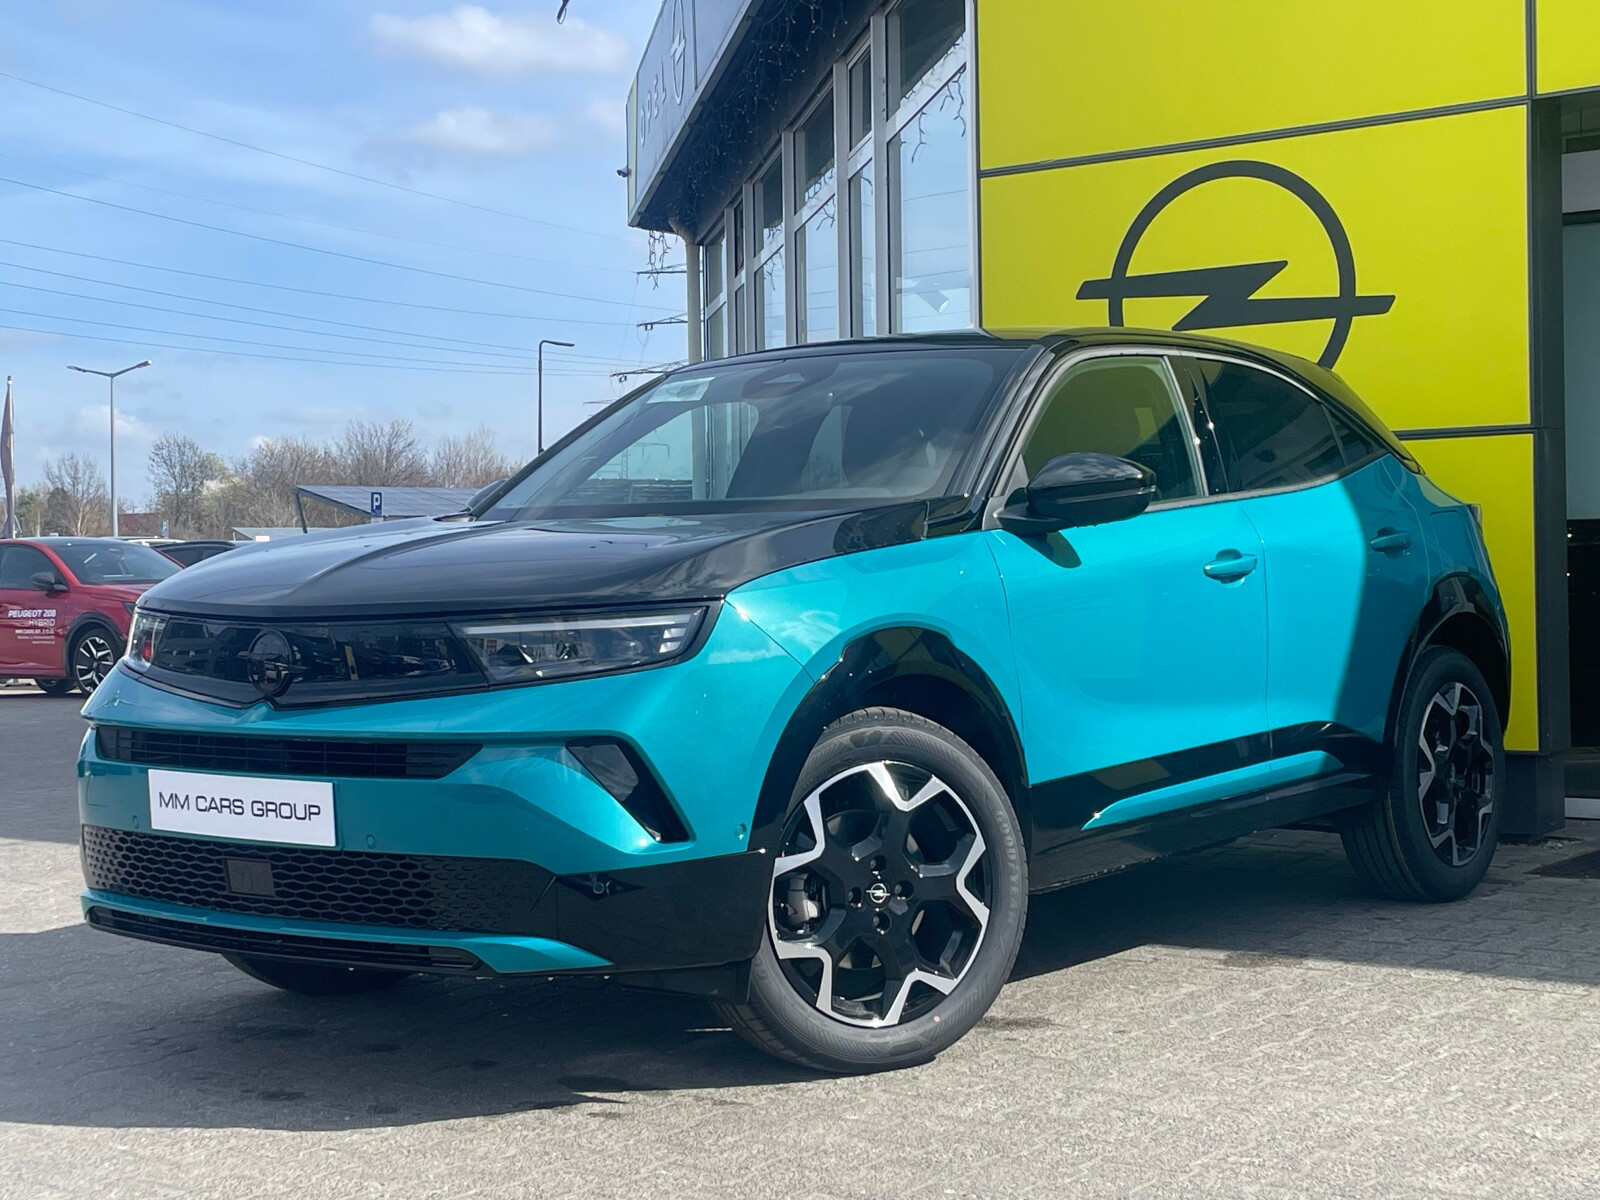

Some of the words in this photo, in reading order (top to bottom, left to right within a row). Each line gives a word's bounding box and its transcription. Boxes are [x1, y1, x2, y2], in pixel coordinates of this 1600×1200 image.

[373, 494, 381, 510] P
[159, 791, 190, 811] MM
[195, 795, 245, 816] CARS
[251, 800, 321, 821] GROUP
[996, 809, 1019, 923] GOODYEAR
